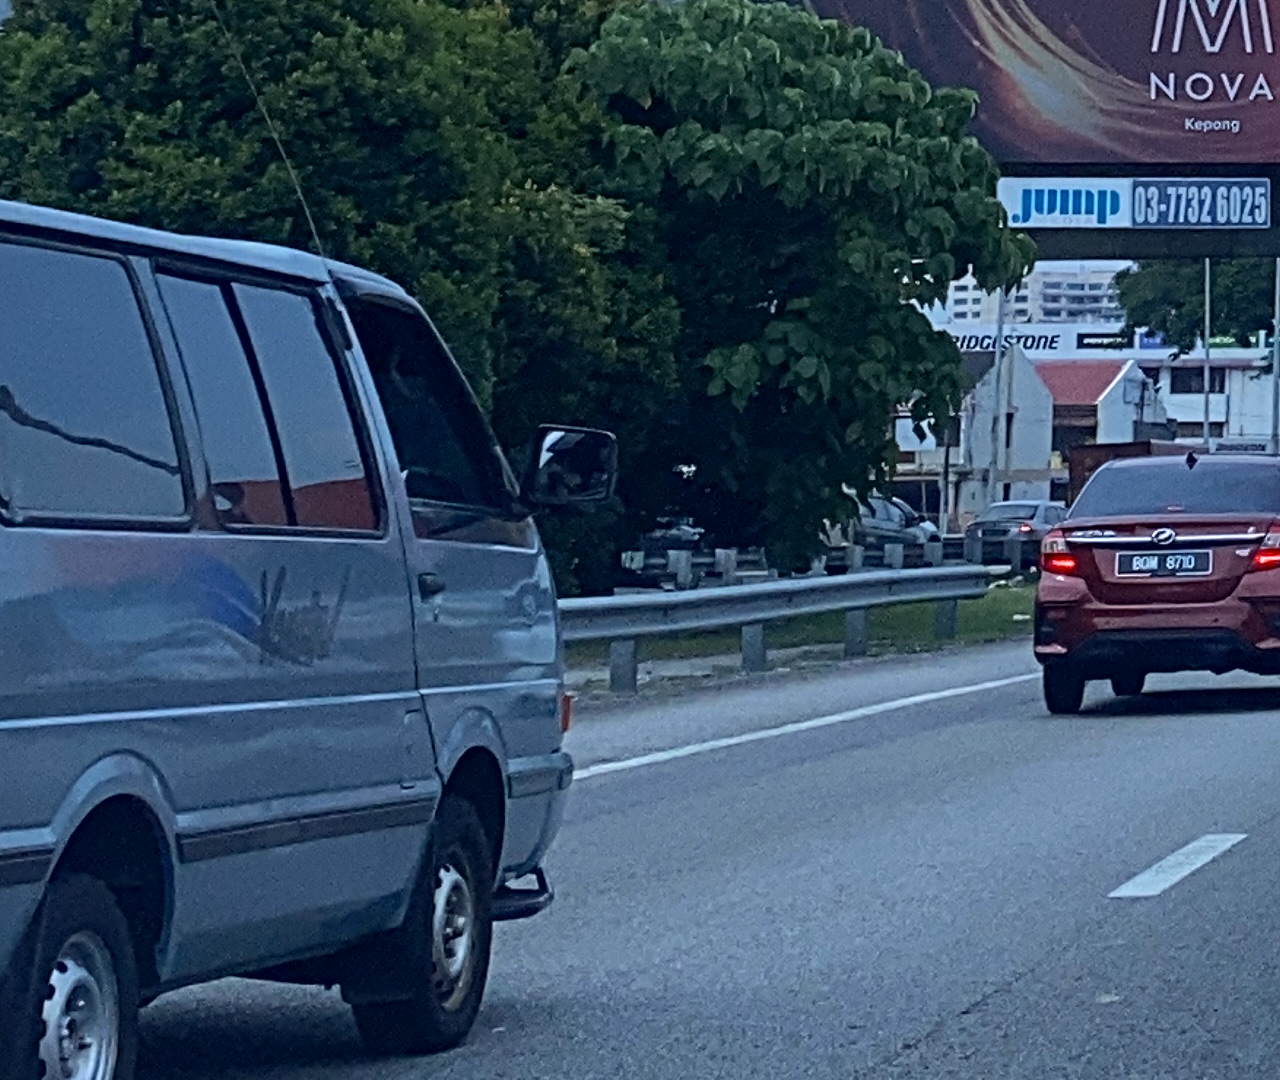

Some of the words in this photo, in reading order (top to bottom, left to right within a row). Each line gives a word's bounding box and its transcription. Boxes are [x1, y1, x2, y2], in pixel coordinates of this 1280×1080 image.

[1150, 72, 1274, 101] NOVA
[1184, 118, 1241, 134] Kepong
[1134, 186, 1212, 224] 03-7732
[1216, 186, 1267, 224] 6025
[950, 334, 1061, 350] IDGSTONE
[1165, 555, 1195, 570] 8710
